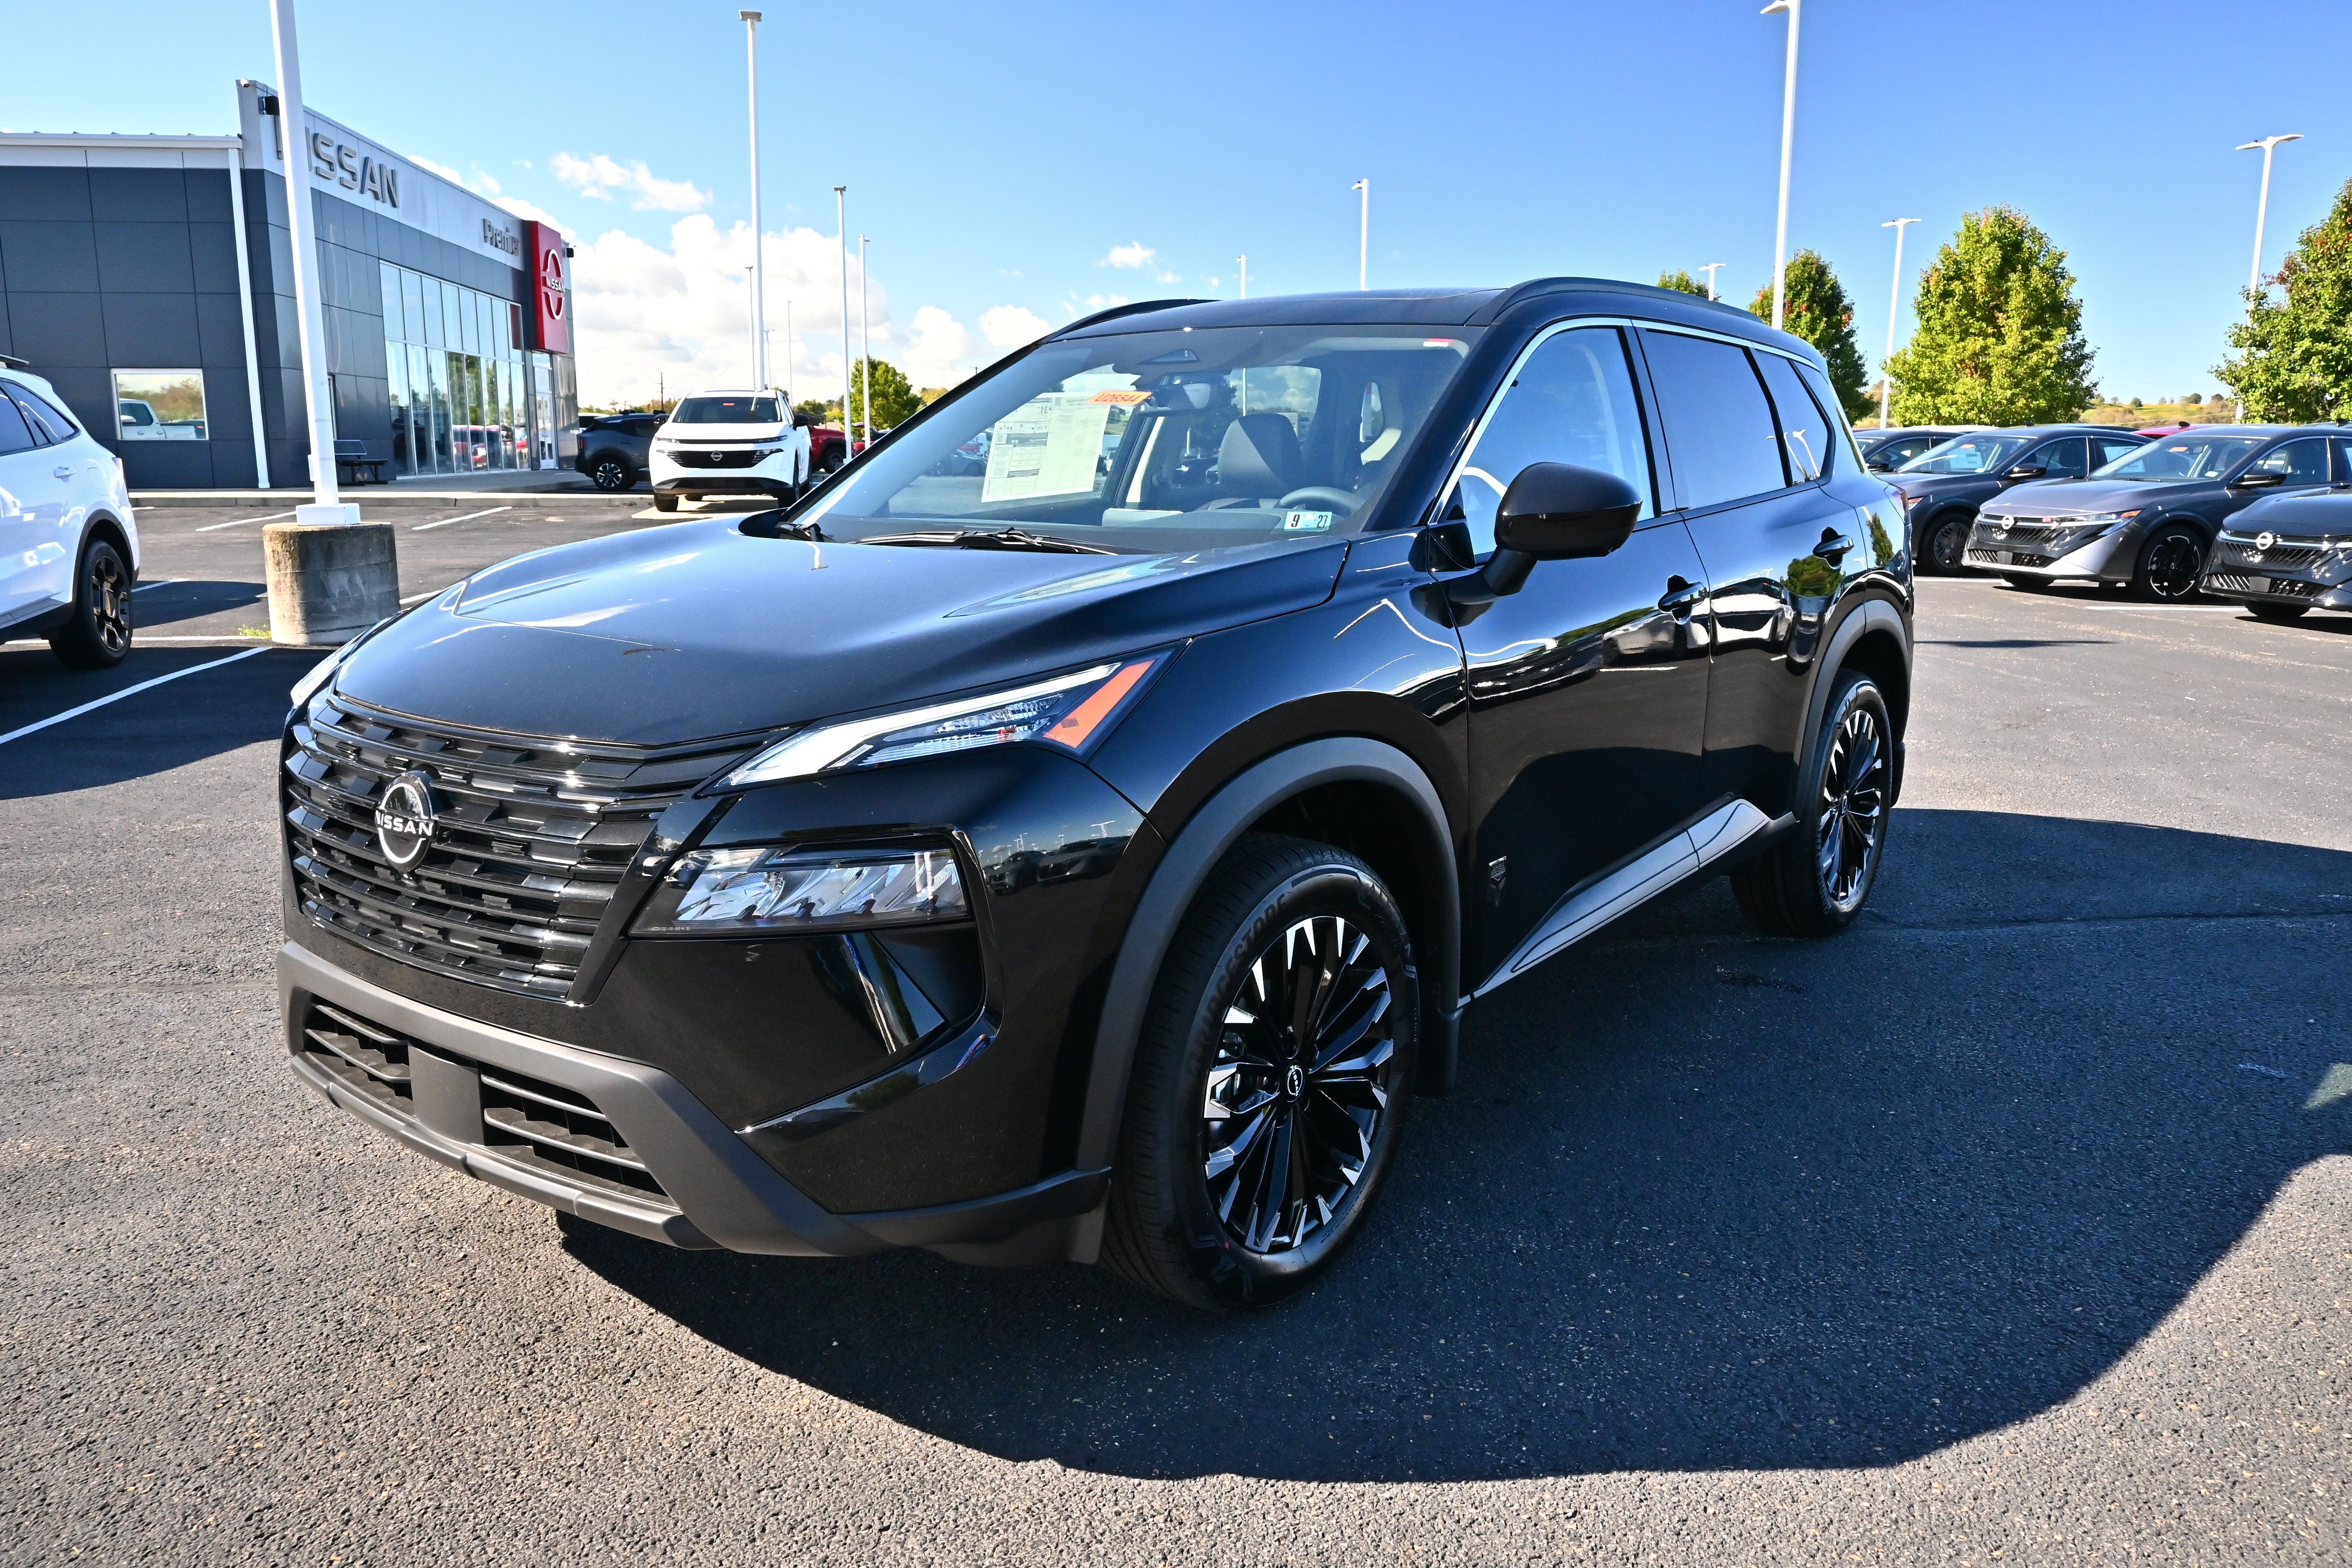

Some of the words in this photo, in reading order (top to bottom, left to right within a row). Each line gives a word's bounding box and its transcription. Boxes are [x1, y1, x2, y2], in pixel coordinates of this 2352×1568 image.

[275, 115, 400, 208] ISSAN
[483, 218, 520, 256] Premier
[546, 276, 565, 293] NISSAN
[1095, 394, 1142, 402] U26544
[1291, 514, 1300, 528] 9
[1317, 514, 1328, 528] 27
[375, 810, 434, 836] NISSAN
